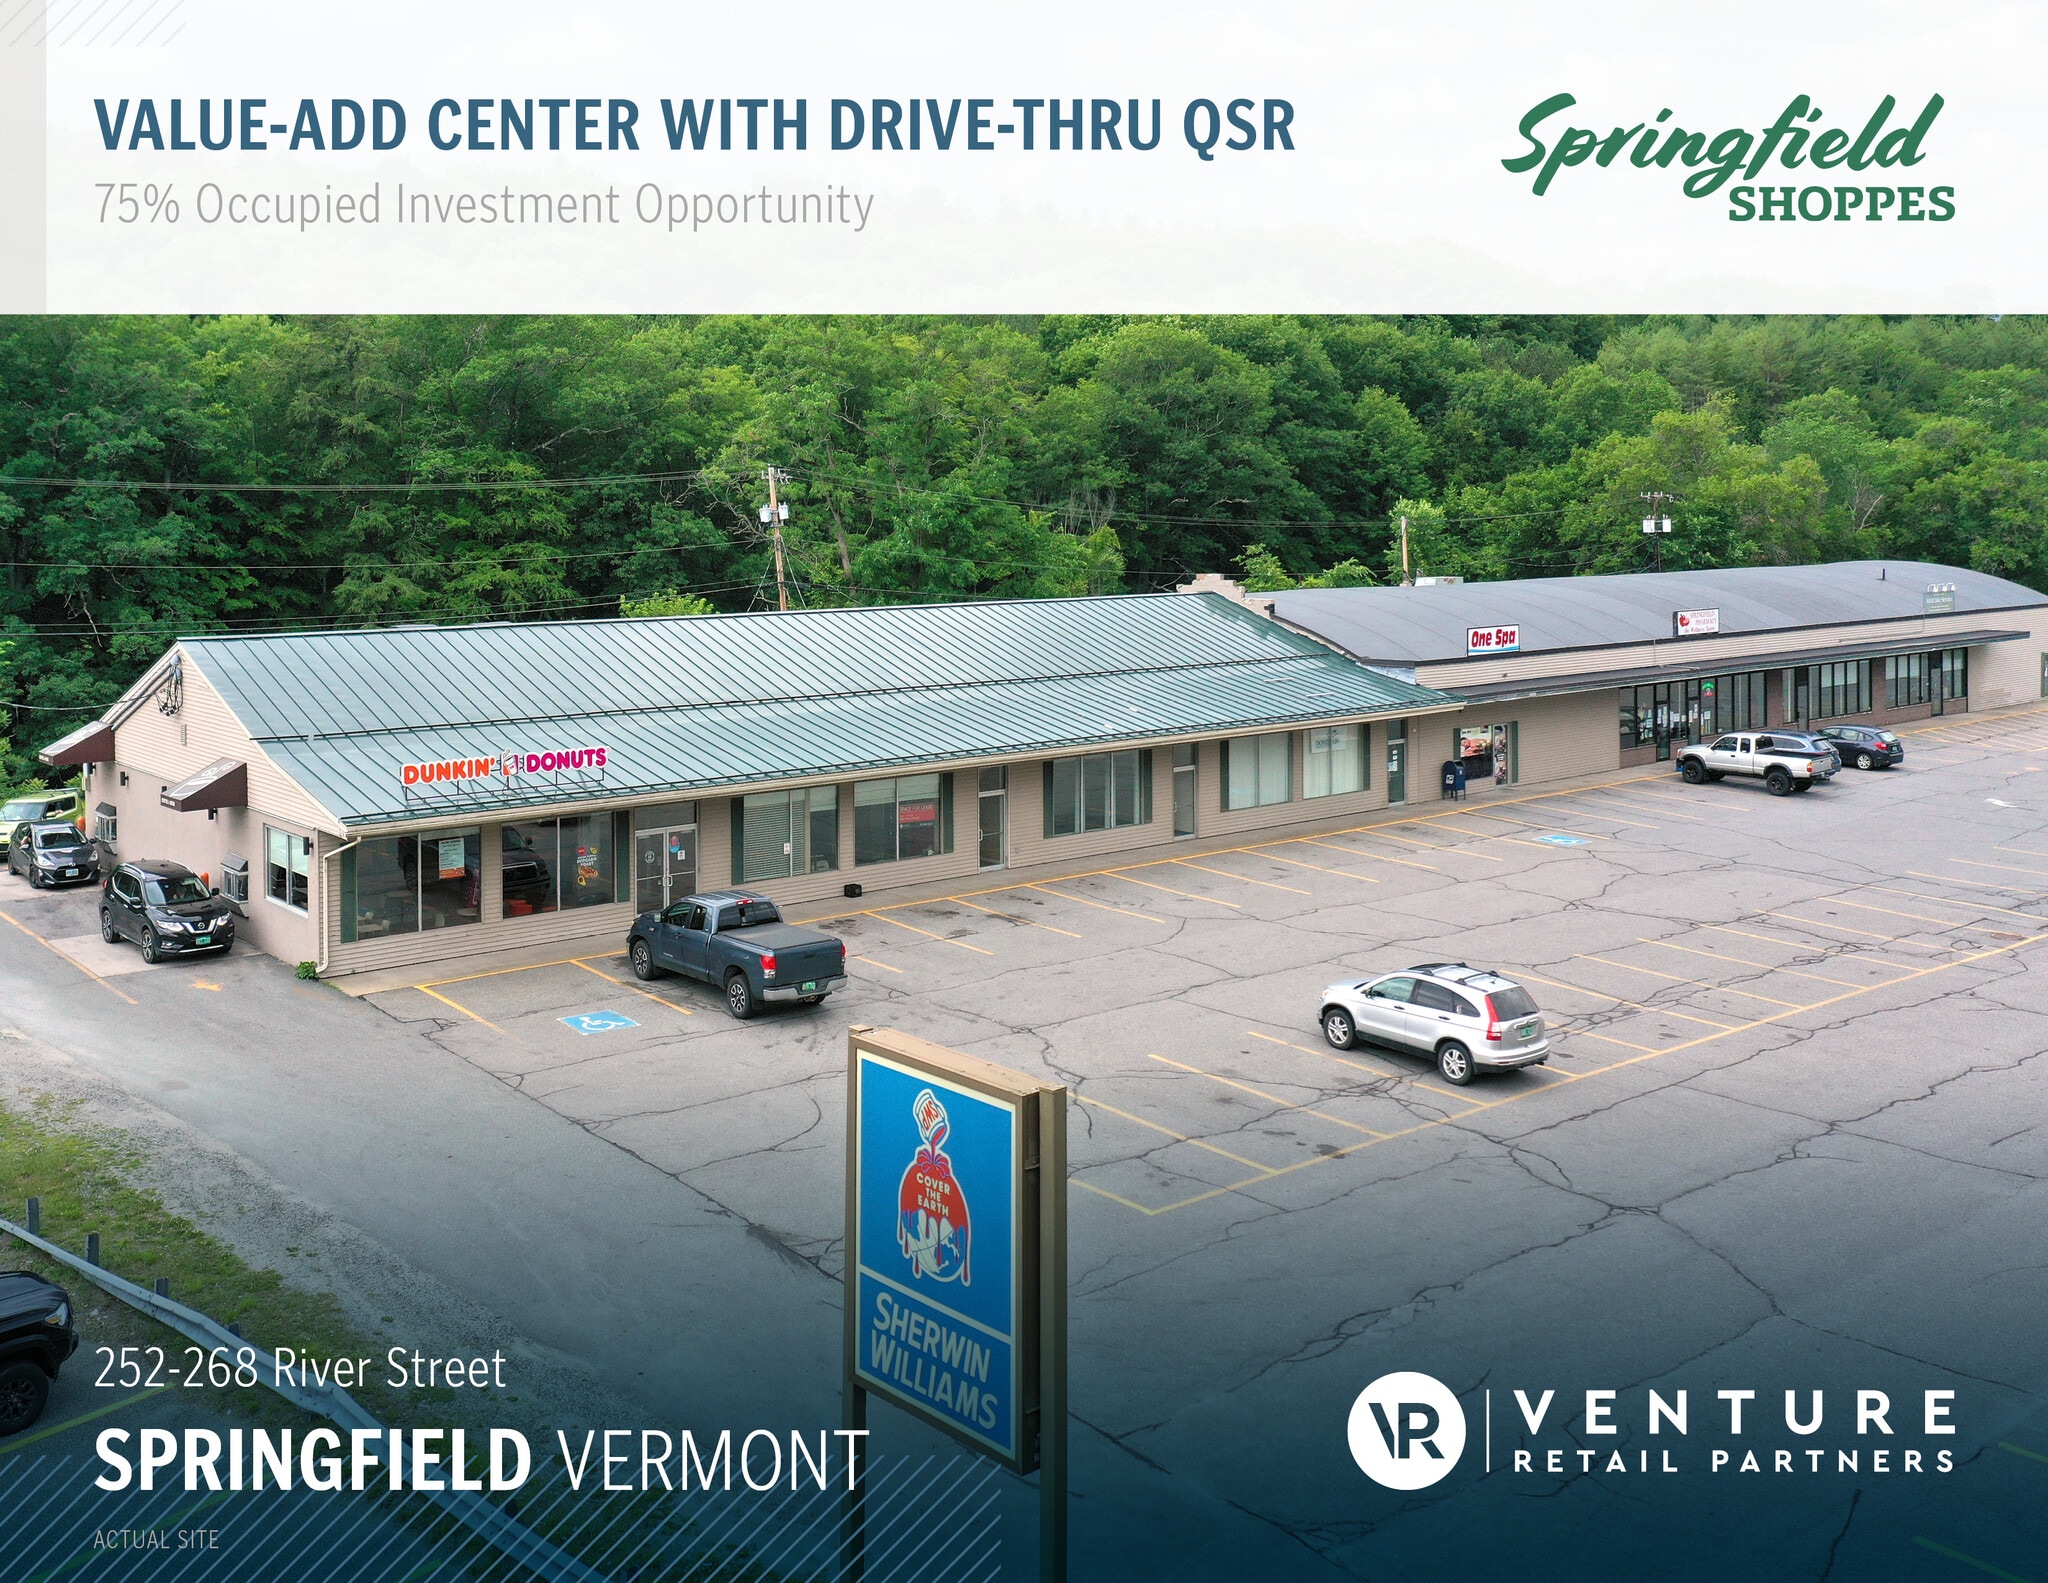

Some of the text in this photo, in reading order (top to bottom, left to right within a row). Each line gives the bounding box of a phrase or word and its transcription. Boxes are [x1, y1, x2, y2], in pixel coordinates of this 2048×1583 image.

[1471, 629, 1516, 648] One Spa
[404, 748, 606, 784] DUNKIN' DONUTS
[916, 1173, 951, 1195] COVER
[926, 1187, 941, 1202] THE
[917, 1194, 949, 1217] EARTH
[873, 1292, 991, 1383] SHERWIN
[871, 1329, 998, 1430] WILLIAMS
